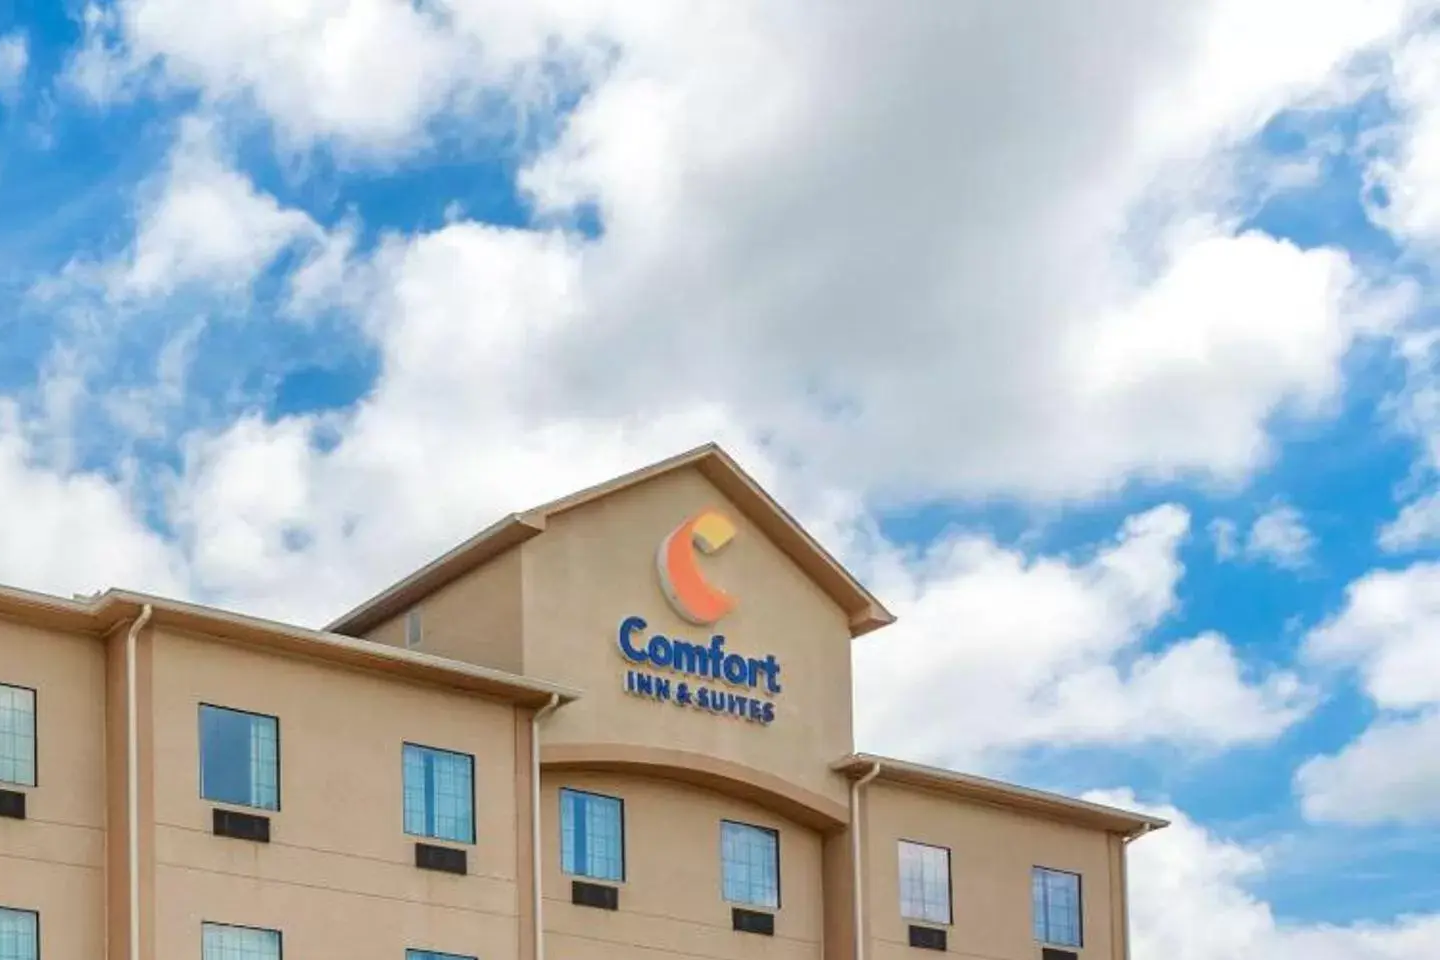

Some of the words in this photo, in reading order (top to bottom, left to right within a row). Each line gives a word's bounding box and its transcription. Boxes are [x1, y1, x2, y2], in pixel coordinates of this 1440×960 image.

[618, 615, 781, 693] Comfort
[625, 670, 671, 702] INN
[675, 683, 692, 706] &
[696, 686, 776, 723] SUITES
